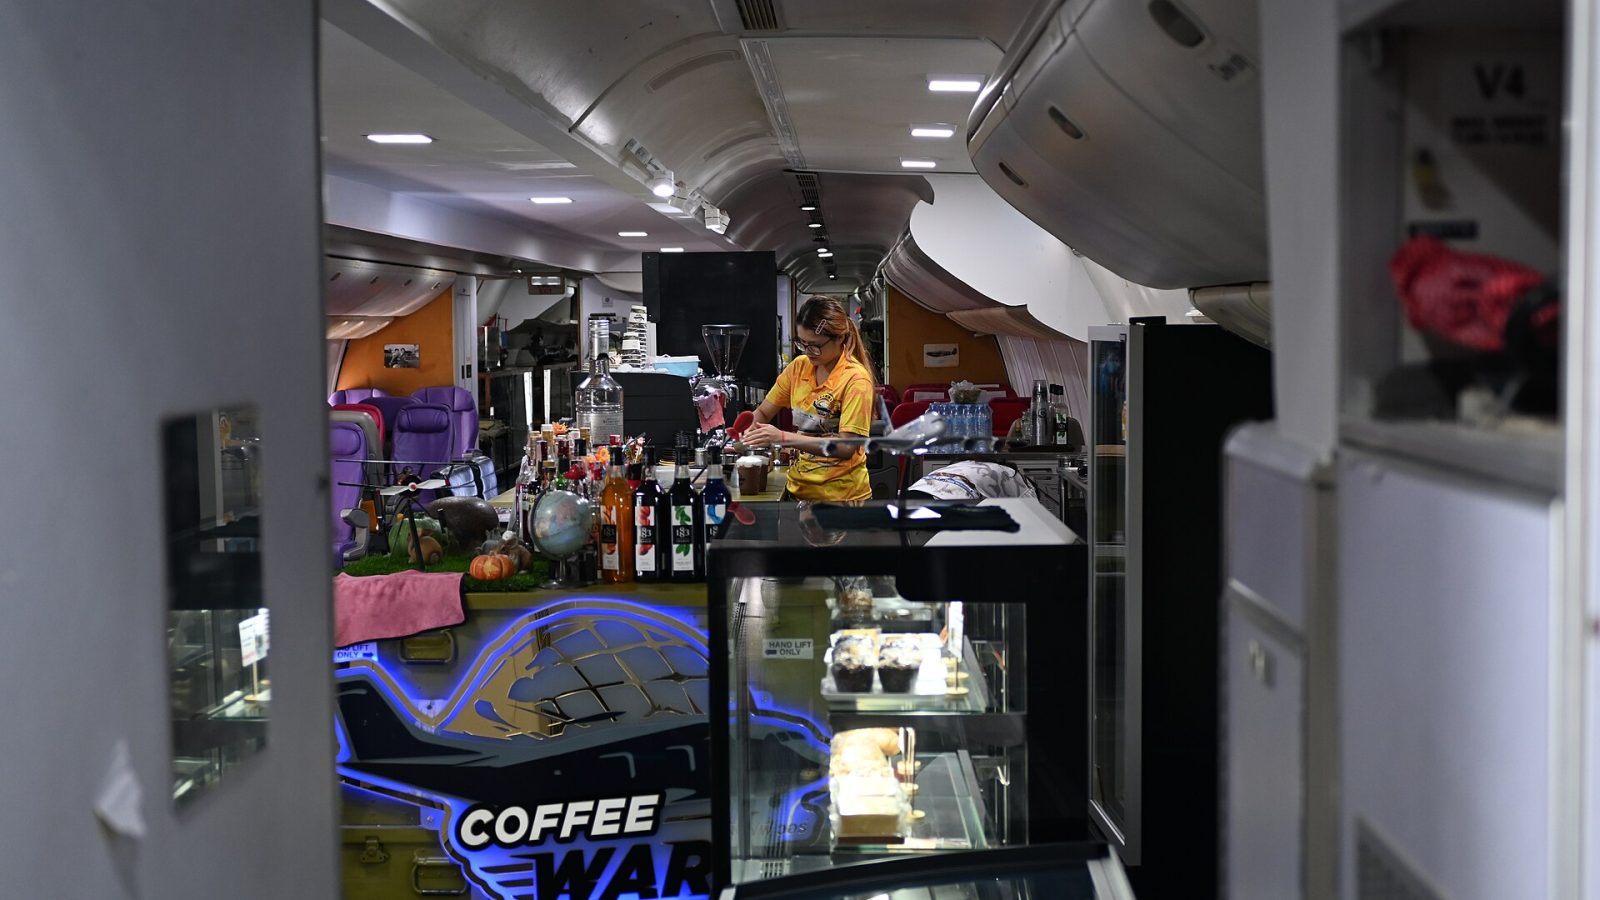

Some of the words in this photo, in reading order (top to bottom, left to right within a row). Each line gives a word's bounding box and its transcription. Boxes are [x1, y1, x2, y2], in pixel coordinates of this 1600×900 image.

[1473, 64, 1525, 98] V4
[769, 641, 793, 649] HAND
[795, 641, 811, 649] LIFT
[460, 794, 660, 846] COFFEE
[522, 841, 711, 900] WAR
